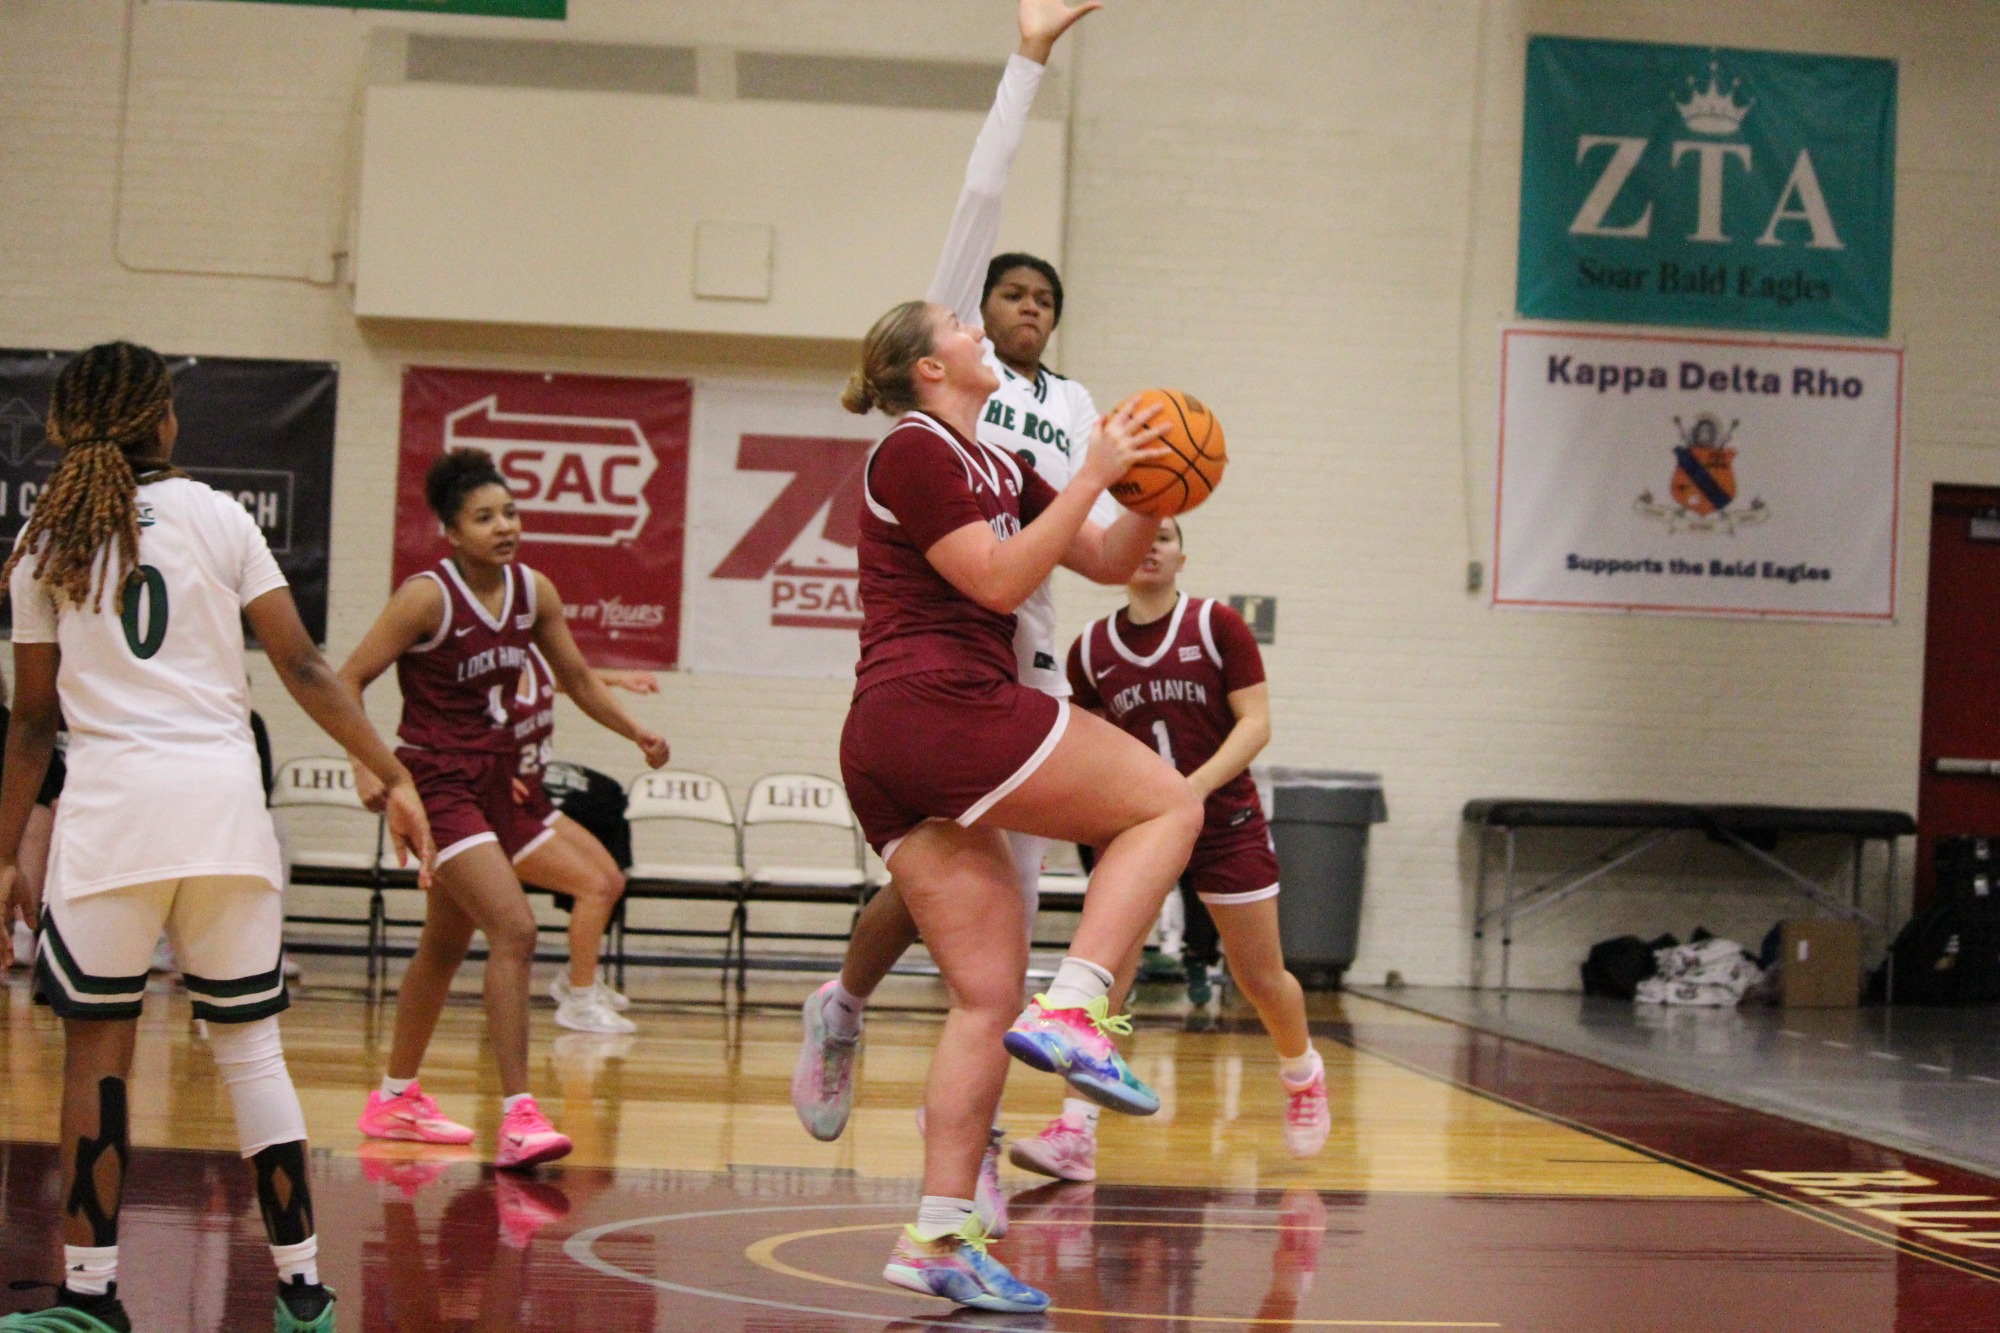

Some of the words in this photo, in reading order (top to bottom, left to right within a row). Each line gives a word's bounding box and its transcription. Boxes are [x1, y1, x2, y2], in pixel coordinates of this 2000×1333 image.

[1568, 134, 1846, 250] ZTA
[1577, 257, 1651, 292] Soar
[1658, 260, 1728, 297] Bald
[1736, 267, 1832, 306] Eagles
[1547, 354, 1668, 395] Kappa
[1679, 362, 1781, 395] Delta
[1792, 367, 1863, 398] Rho
[984, 399, 1016, 431] HE
[1022, 411, 1070, 457] ROC
[498, 450, 641, 506] SAC
[1566, 552, 1664, 578] Supports
[1669, 556, 1704, 576] the
[1709, 559, 1757, 579] Bald
[1761, 562, 1831, 583] Eagles
[121, 564, 168, 660] 0
[1149, 679, 1207, 706] HAVEN
[1152, 719, 1177, 769] 1
[292, 768, 354, 790] LHU
[646, 778, 712, 801] LHU
[768, 784, 834, 808] LHU
